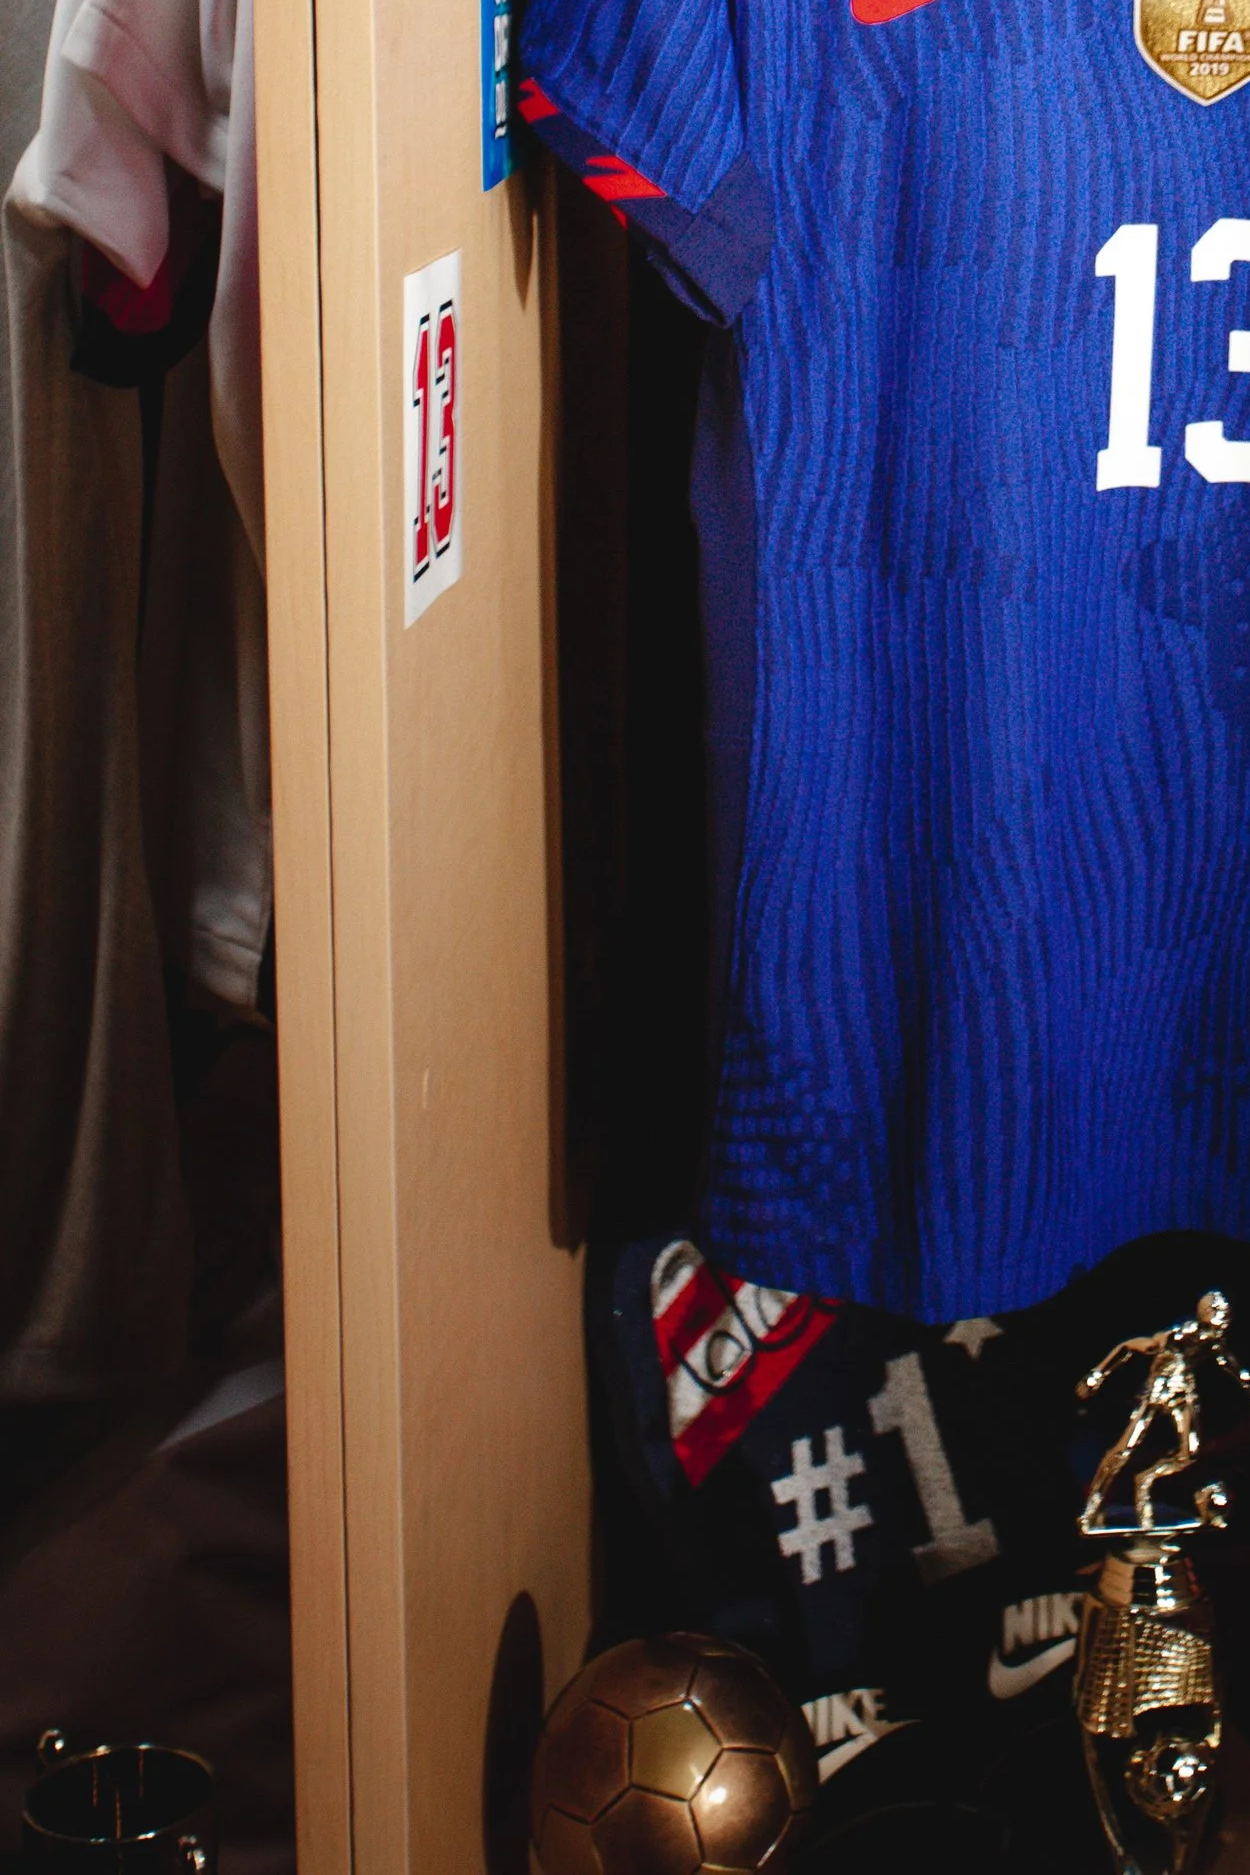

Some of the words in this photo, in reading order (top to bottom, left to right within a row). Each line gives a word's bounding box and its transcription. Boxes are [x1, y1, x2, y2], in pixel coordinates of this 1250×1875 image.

[1177, 29, 1246, 54] FIFA
[1189, 62, 1230, 77] 2019
[413, 297, 457, 584] 13
[1002, 1590, 1081, 1656] NIK
